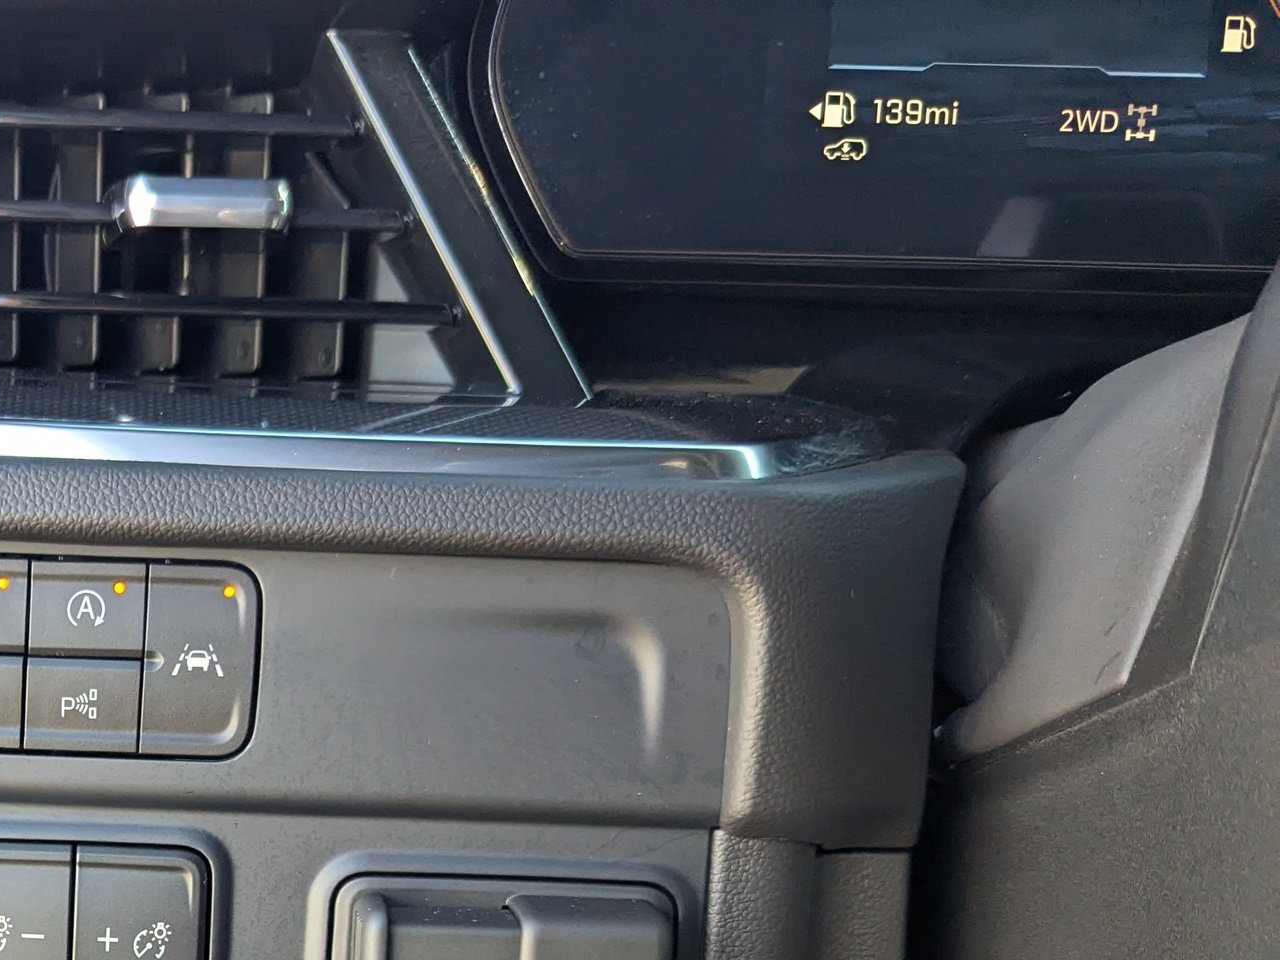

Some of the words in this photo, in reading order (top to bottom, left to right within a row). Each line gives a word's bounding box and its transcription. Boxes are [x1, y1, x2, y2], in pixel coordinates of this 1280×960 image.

[872, 99, 960, 127] 139mi
[1059, 109, 1119, 134] 2WD
[76, 594, 96, 617] A
